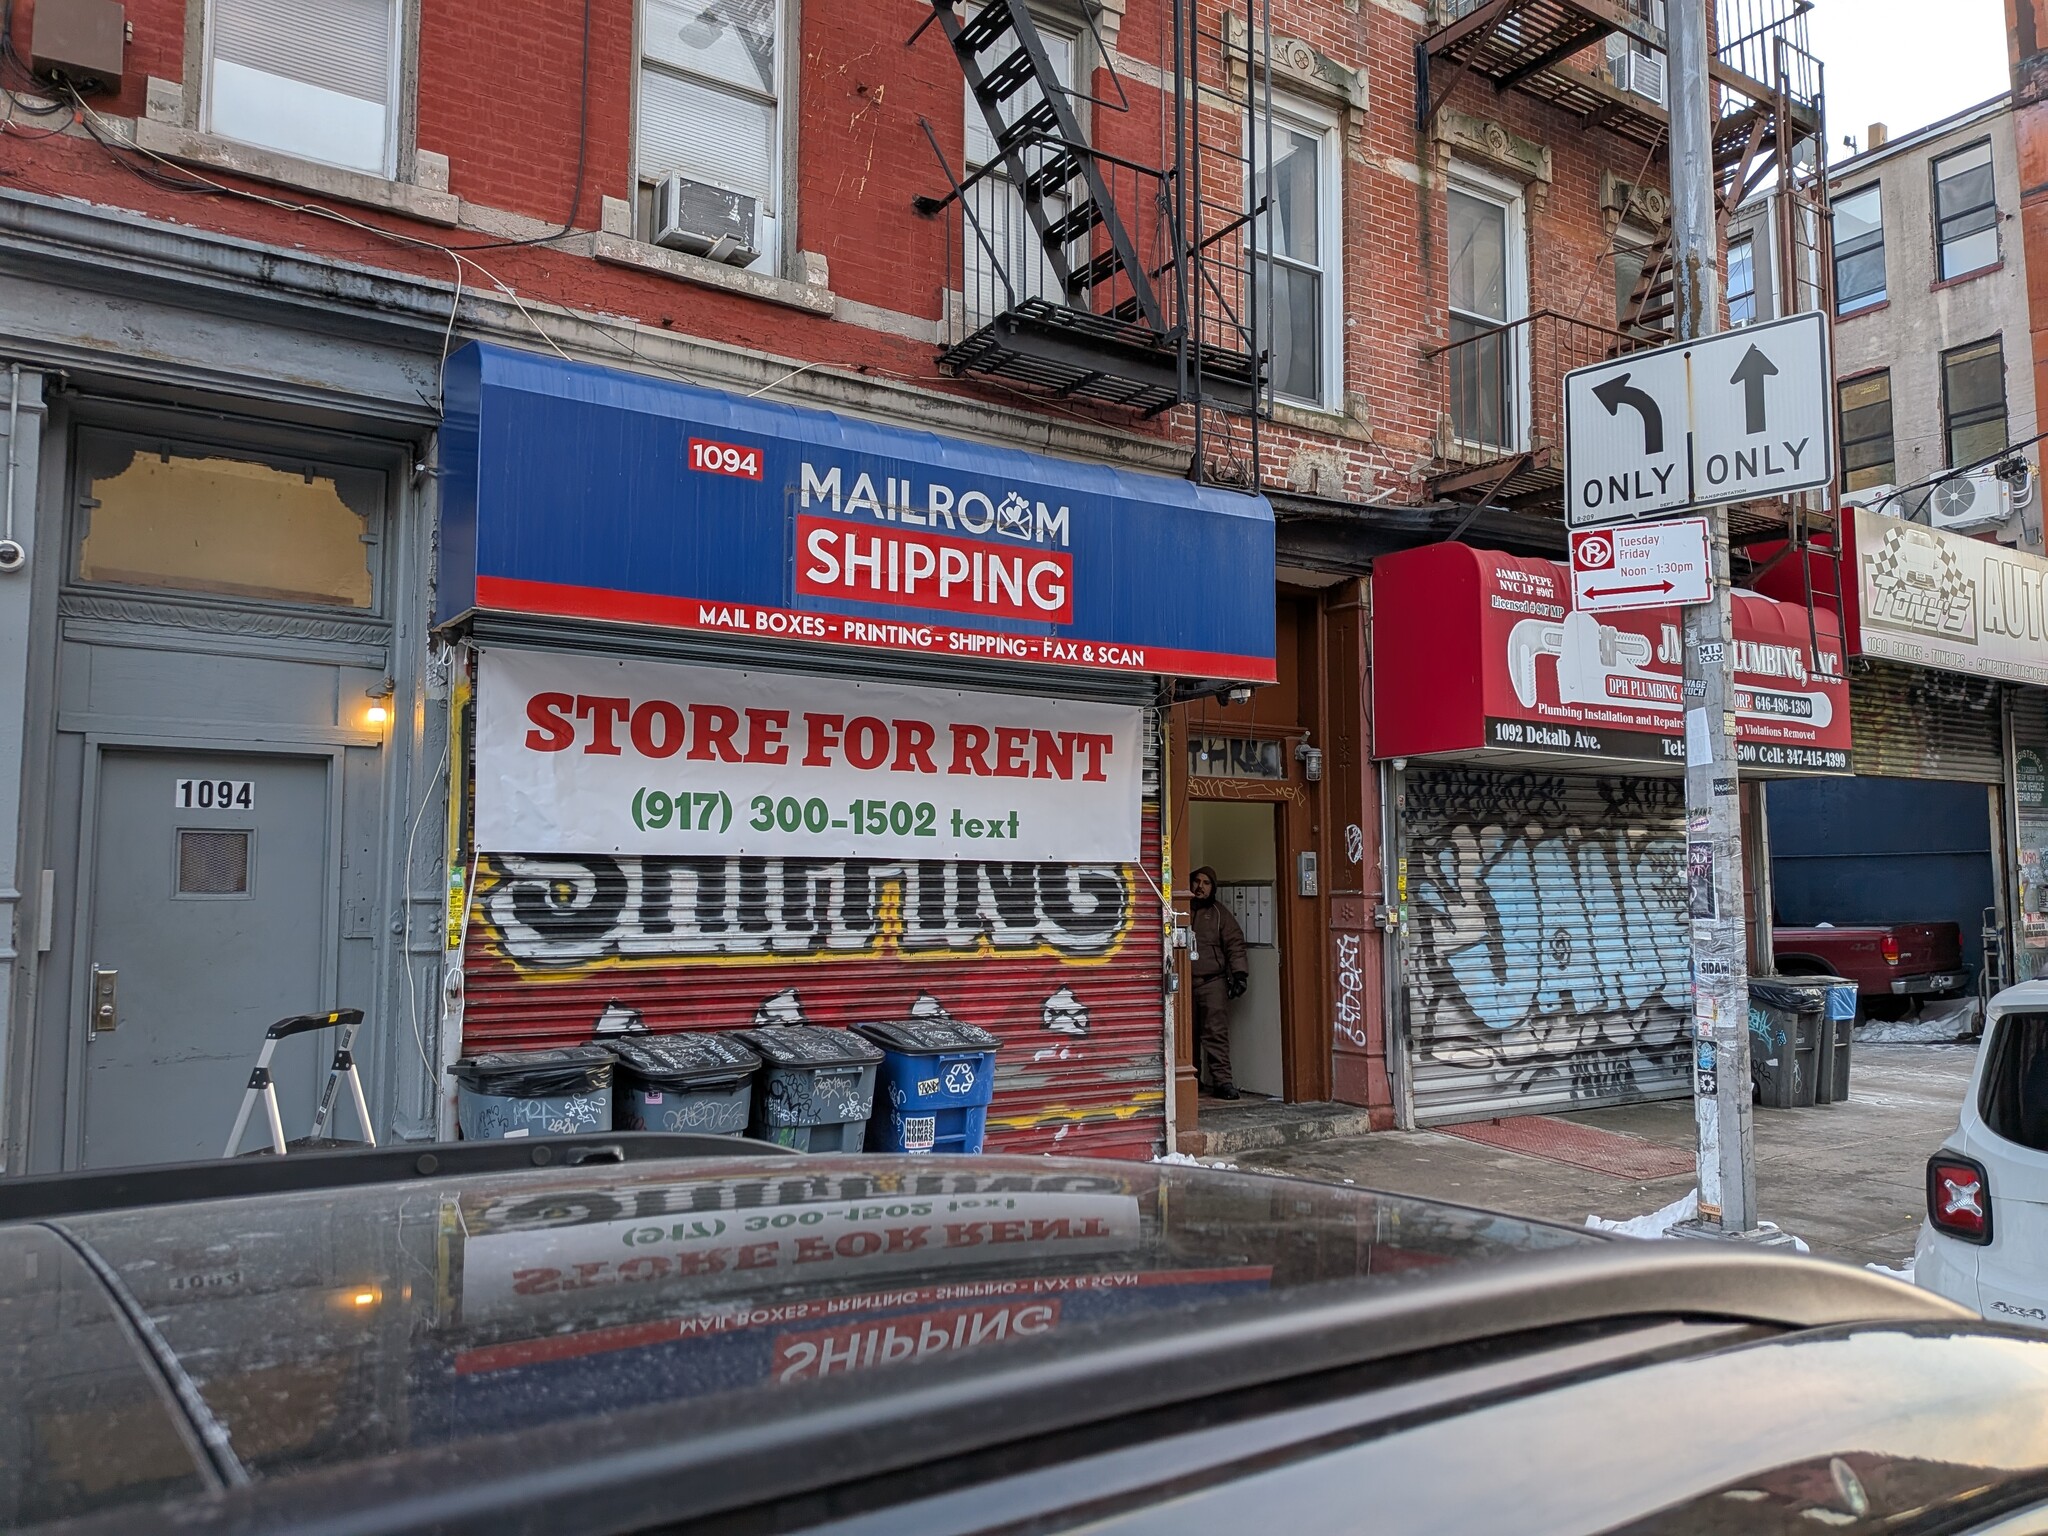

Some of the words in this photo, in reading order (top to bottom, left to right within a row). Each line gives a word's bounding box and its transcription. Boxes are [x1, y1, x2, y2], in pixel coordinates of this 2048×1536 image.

[693, 443, 757, 476] 1094
[1706, 437, 1810, 485] ONLY
[1583, 463, 1676, 508] ONLY
[1697, 488, 1747, 501] TRANSPORTATION
[1618, 535, 1660, 548] Tuesday
[1619, 548, 1651, 560] Friday
[805, 528, 1065, 611] SHIPPING
[1495, 568, 1528, 582] JAMES
[1529, 574, 1554, 588] PEPE
[1620, 566, 1647, 577] Noon
[1656, 561, 1694, 575] 1:30pm
[1499, 580, 1520, 592] NYC
[1523, 583, 1534, 595] LP
[1491, 595, 1529, 613] Licensed
[1551, 606, 1564, 618] MP
[699, 604, 750, 630] MAIL
[1043, 641, 1078, 661] FAX
[1083, 645, 1094, 662] &
[1098, 647, 1144, 667] SCAN
[1700, 644, 1723, 655] MIJ
[1700, 653, 1724, 663] XXX
[1867, 637, 1888, 654] 1090
[1892, 642, 1923, 660] BRAKES
[1951, 653, 1966, 668] UPS
[1976, 657, 2012, 675] COMPUTER
[1732, 640, 1807, 687] LUMBING,
[1609, 678, 1629, 695] DPH
[1631, 680, 1678, 700] PLUMBING
[1734, 693, 1752, 709] ORP.
[1755, 694, 1811, 715] 646-486-1380
[1538, 703, 1582, 720] Plumbing
[1584, 708, 1634, 724] Installation
[1636, 714, 1651, 725] and
[1653, 716, 1684, 729] Repairs
[1745, 724, 1782, 738] Violations
[1783, 728, 1816, 741] Removed
[524, 691, 790, 766] STORE
[802, 712, 938, 776] FOR
[948, 722, 1113, 782] RENT
[1495, 723, 1523, 742] 1092
[1526, 725, 1570, 747] Dekalb
[1574, 731, 1601, 750] Ave.
[1662, 739, 1684, 756] Tel:
[1737, 744, 1756, 762] 500
[1759, 746, 1785, 764] Cell:
[1787, 749, 1846, 768] 347-415-4399
[2015, 749, 2044, 772] EGISTERED
[181, 780, 252, 809] 1094
[2016, 781, 2027, 791] OTOR
[2016, 792, 2031, 801] EPAIR
[631, 785, 733, 834] (917)
[749, 795, 938, 839] 300-1502
[951, 808, 1020, 840] text
[906, 1118, 934, 1127] NOMAS
[906, 1126, 934, 1135] NOMAS
[905, 1134, 934, 1143] NOMAS
